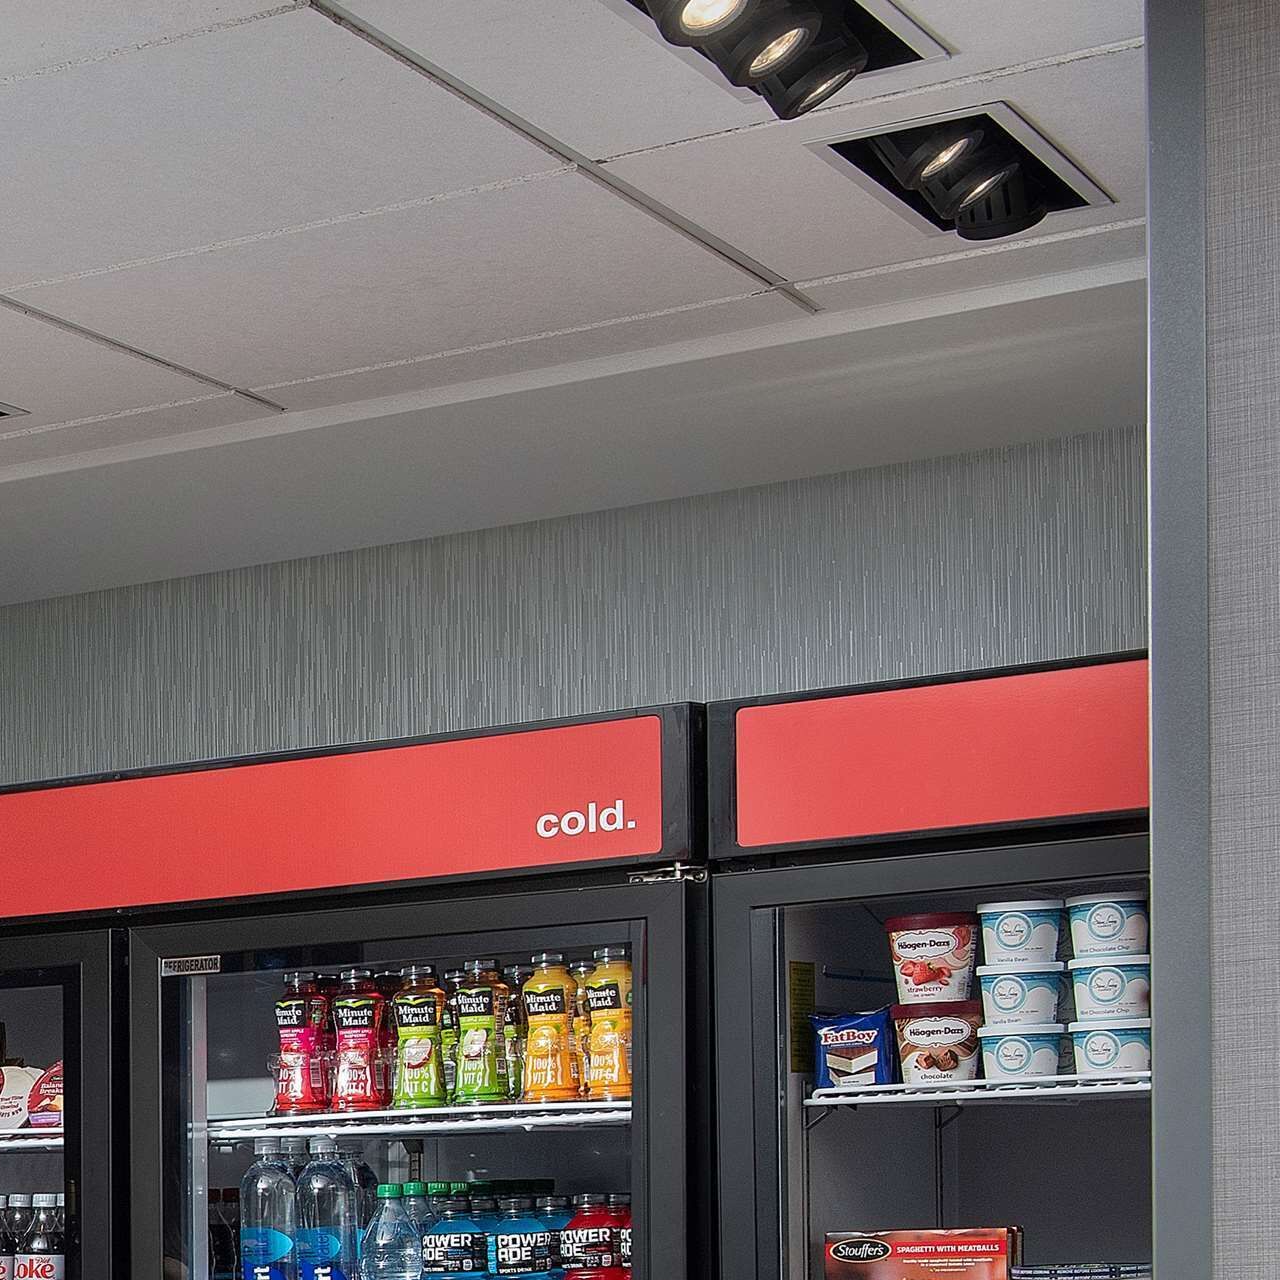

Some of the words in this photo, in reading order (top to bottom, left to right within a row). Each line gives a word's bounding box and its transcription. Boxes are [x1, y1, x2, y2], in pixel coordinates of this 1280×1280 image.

[536, 799, 638, 838] cold.
[1089, 945, 1117, 953] Chocolate
[163, 958, 219, 973] REFRIGERATOR
[907, 985, 943, 993] strawberry
[457, 992, 490, 1005] Minute
[525, 993, 561, 1004] Minute
[589, 997, 614, 1008] Maid
[338, 1007, 373, 1019] Minute
[398, 1004, 434, 1015] Minute
[460, 1003, 486, 1013] Maid
[529, 1002, 558, 1012] Maid
[342, 1016, 369, 1026] Maid
[402, 1013, 430, 1023] Maid
[822, 1028, 877, 1044] FatBoy
[920, 1072, 953, 1080] chocolate
[423, 1233, 472, 1248] POWER
[497, 1232, 551, 1248] POWER
[560, 1229, 610, 1245] POWER
[423, 1247, 445, 1262] ADE
[497, 1246, 532, 1263] ADE
[560, 1242, 582, 1258] ADE
[837, 1242, 884, 1259] Stouffer's
[896, 1245, 935, 1254] SPAGHETTI
[936, 1245, 957, 1253] WITH
[958, 1244, 1000, 1252] MEATBALLS
